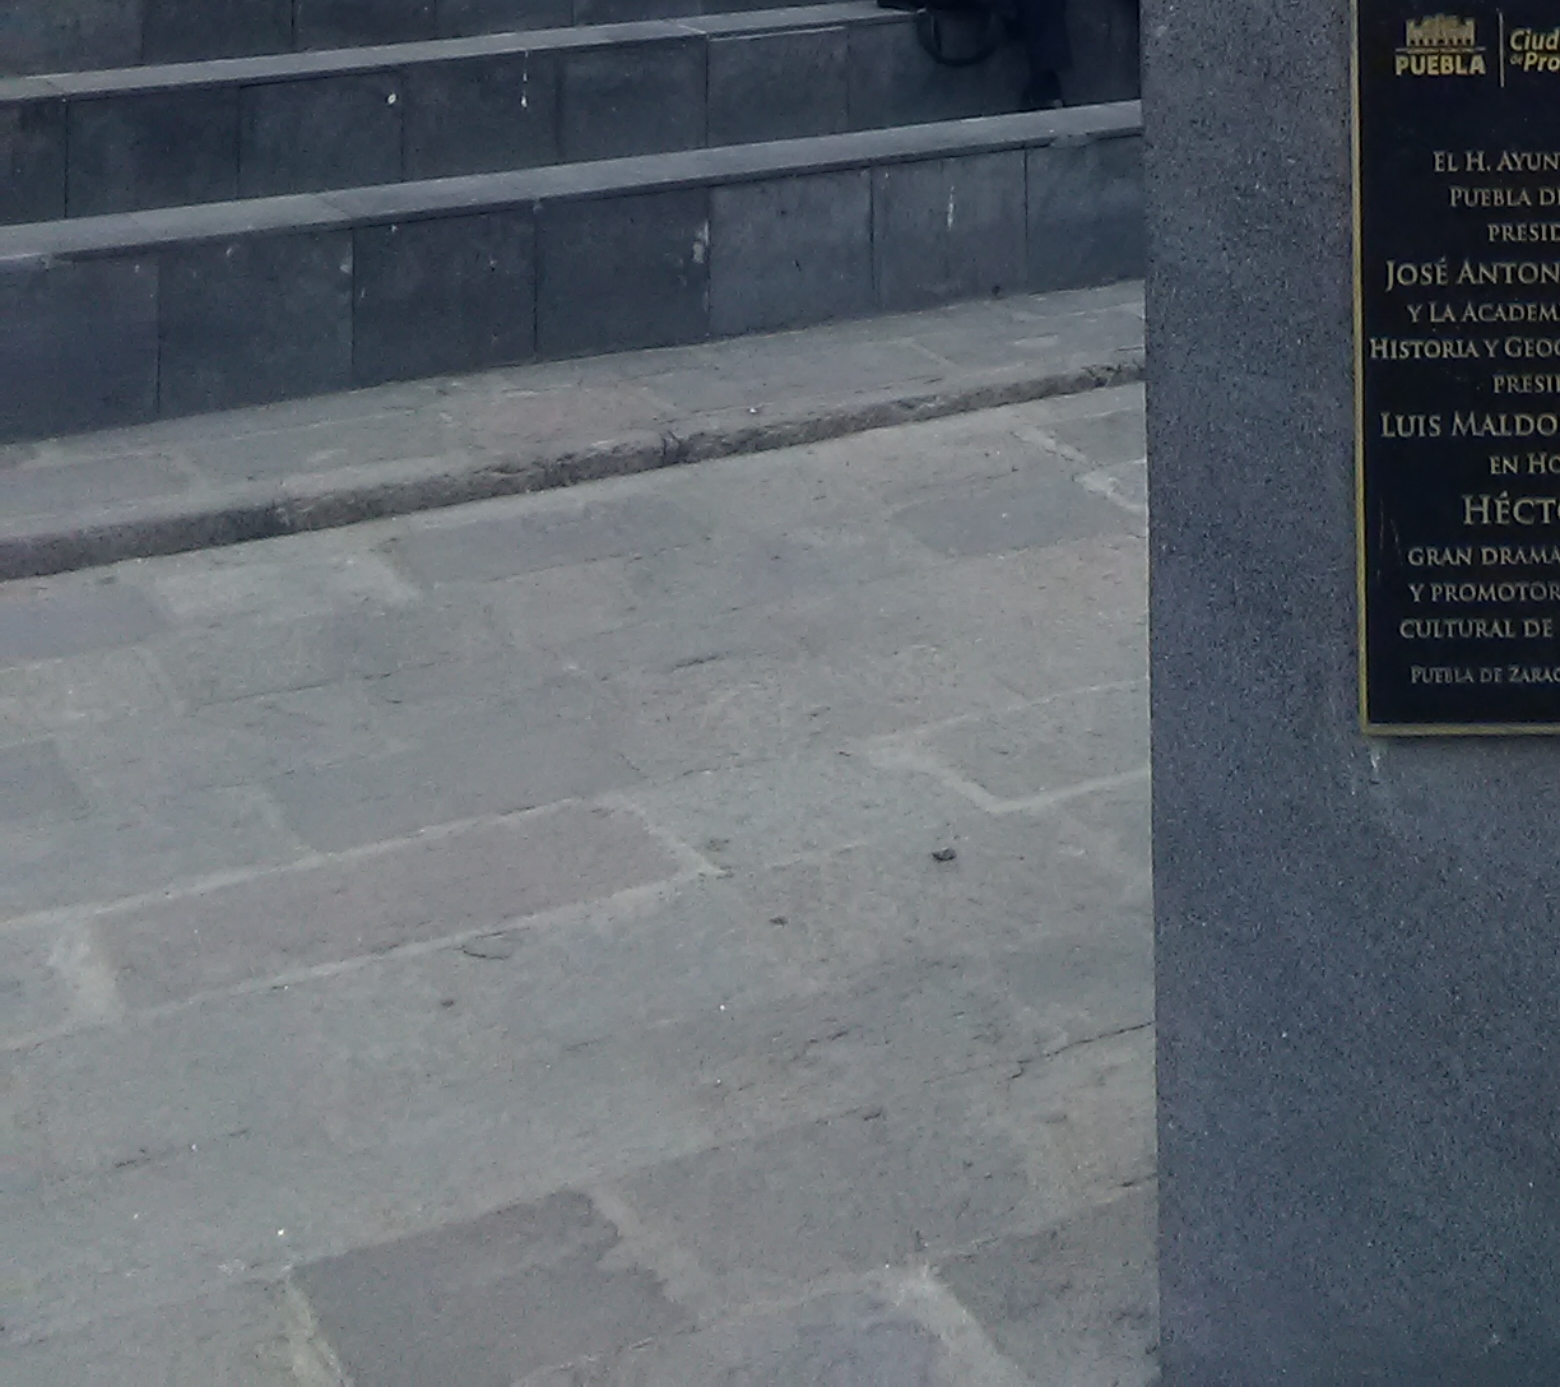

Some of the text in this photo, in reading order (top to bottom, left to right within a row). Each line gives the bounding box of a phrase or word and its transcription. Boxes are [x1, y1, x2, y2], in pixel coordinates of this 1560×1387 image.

[1396, 53, 1485, 75] PUEBLA
[1434, 151, 1458, 171] EL
[1466, 151, 1490, 171] H.
[1451, 187, 1532, 207] PUEBLA
[1386, 257, 1447, 291] JOSÉ
[1407, 305, 1422, 322] Y
[1430, 303, 1456, 322] LA
[1370, 338, 1479, 359] HISTORIA
[1484, 340, 1499, 357] Y
[1381, 413, 1441, 437] LUIS
[1490, 456, 1517, 474] EN
[1408, 547, 1472, 566] GRAN
[1409, 584, 1424, 602] Y
[1400, 619, 1515, 638] CULTURAL
[1524, 619, 1552, 637] DE
[1411, 666, 1474, 683] PUEBLA
